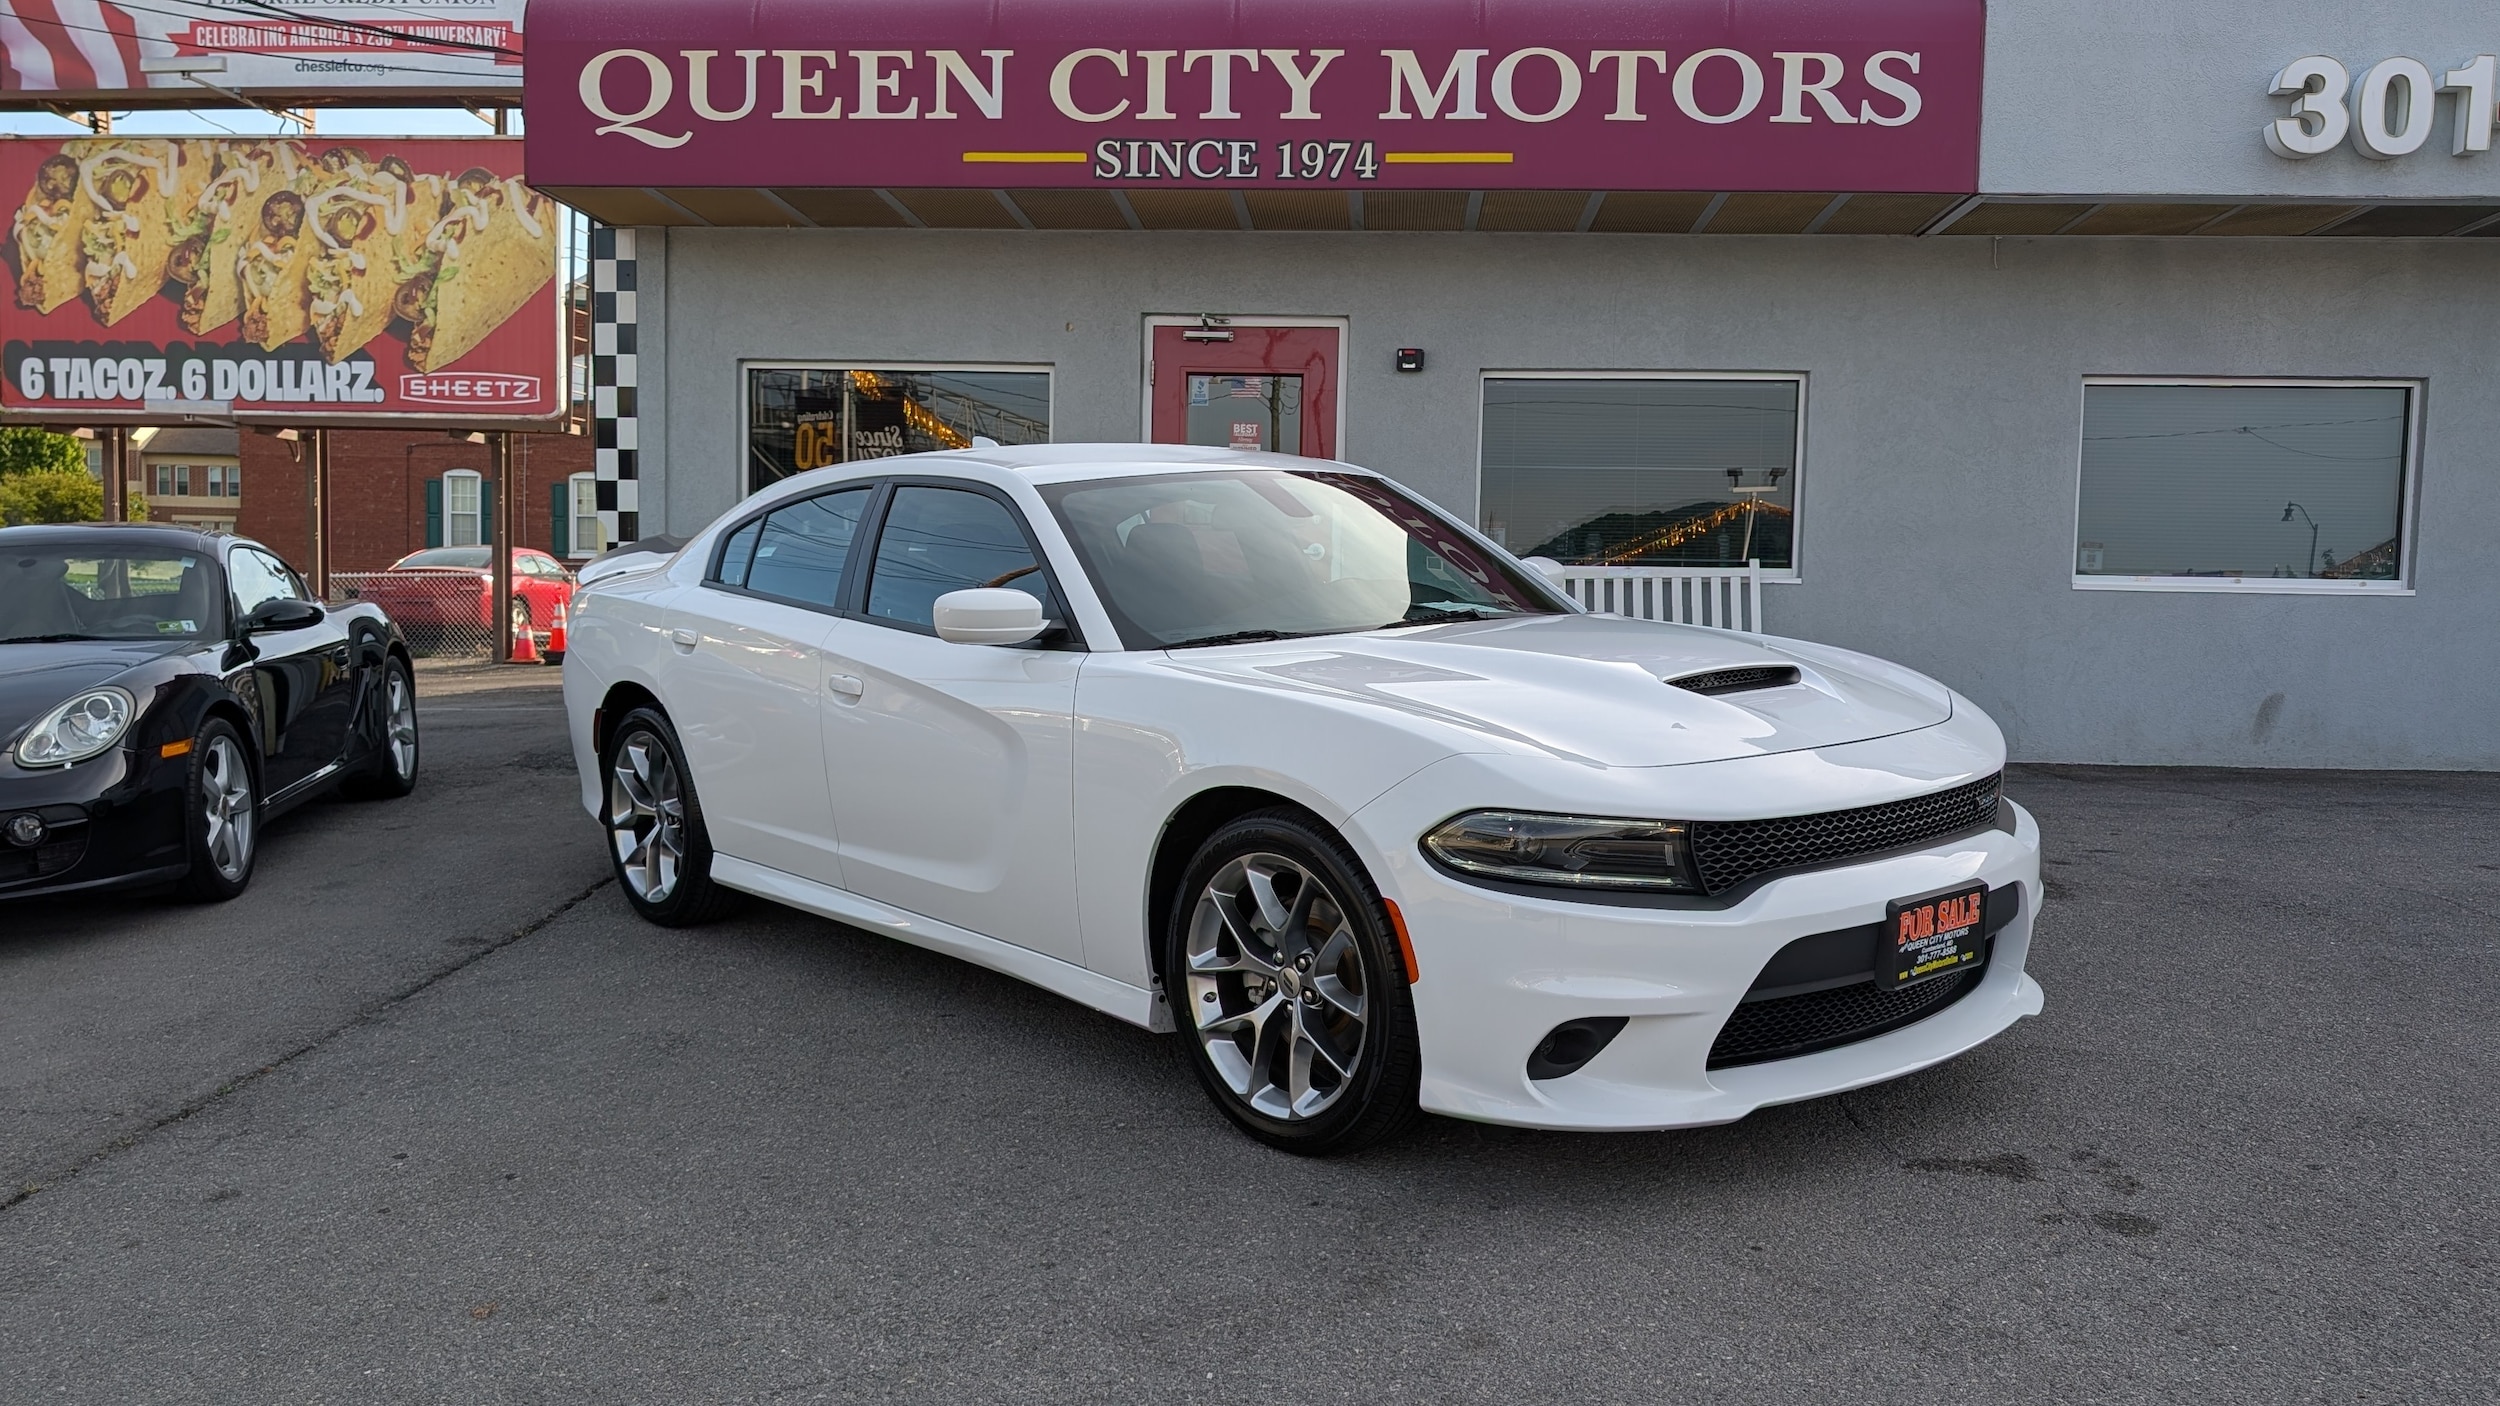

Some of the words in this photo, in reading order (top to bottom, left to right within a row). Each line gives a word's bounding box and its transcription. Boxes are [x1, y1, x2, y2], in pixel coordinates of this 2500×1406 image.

[196, 26, 287, 47] CELEBRATING
[289, 25, 364, 47] AMERICA'S
[407, 26, 507, 47] ANNIVERSARY!
[578, 47, 1014, 150] QUEEN
[1047, 47, 1345, 124] CITY
[1378, 47, 1924, 127] MOTORS
[2263, 54, 2497, 160] 301
[1093, 139, 1260, 179] SINCE
[1275, 140, 1380, 180] 1974
[20, 357, 46, 400] 6
[50, 357, 177, 400] TACOZ.
[181, 358, 207, 401] 6
[212, 359, 385, 403] DOLLARZ.
[410, 379, 530, 398] SHEETZ
[1233, 423, 1259, 434] BEST
[1898, 905, 1935, 945] FOR
[1937, 893, 1981, 934] SALE
[1907, 937, 1929, 952] QUEEN
[1929, 932, 1944, 945] CITY
[1943, 927, 1970, 941] MOTORS
